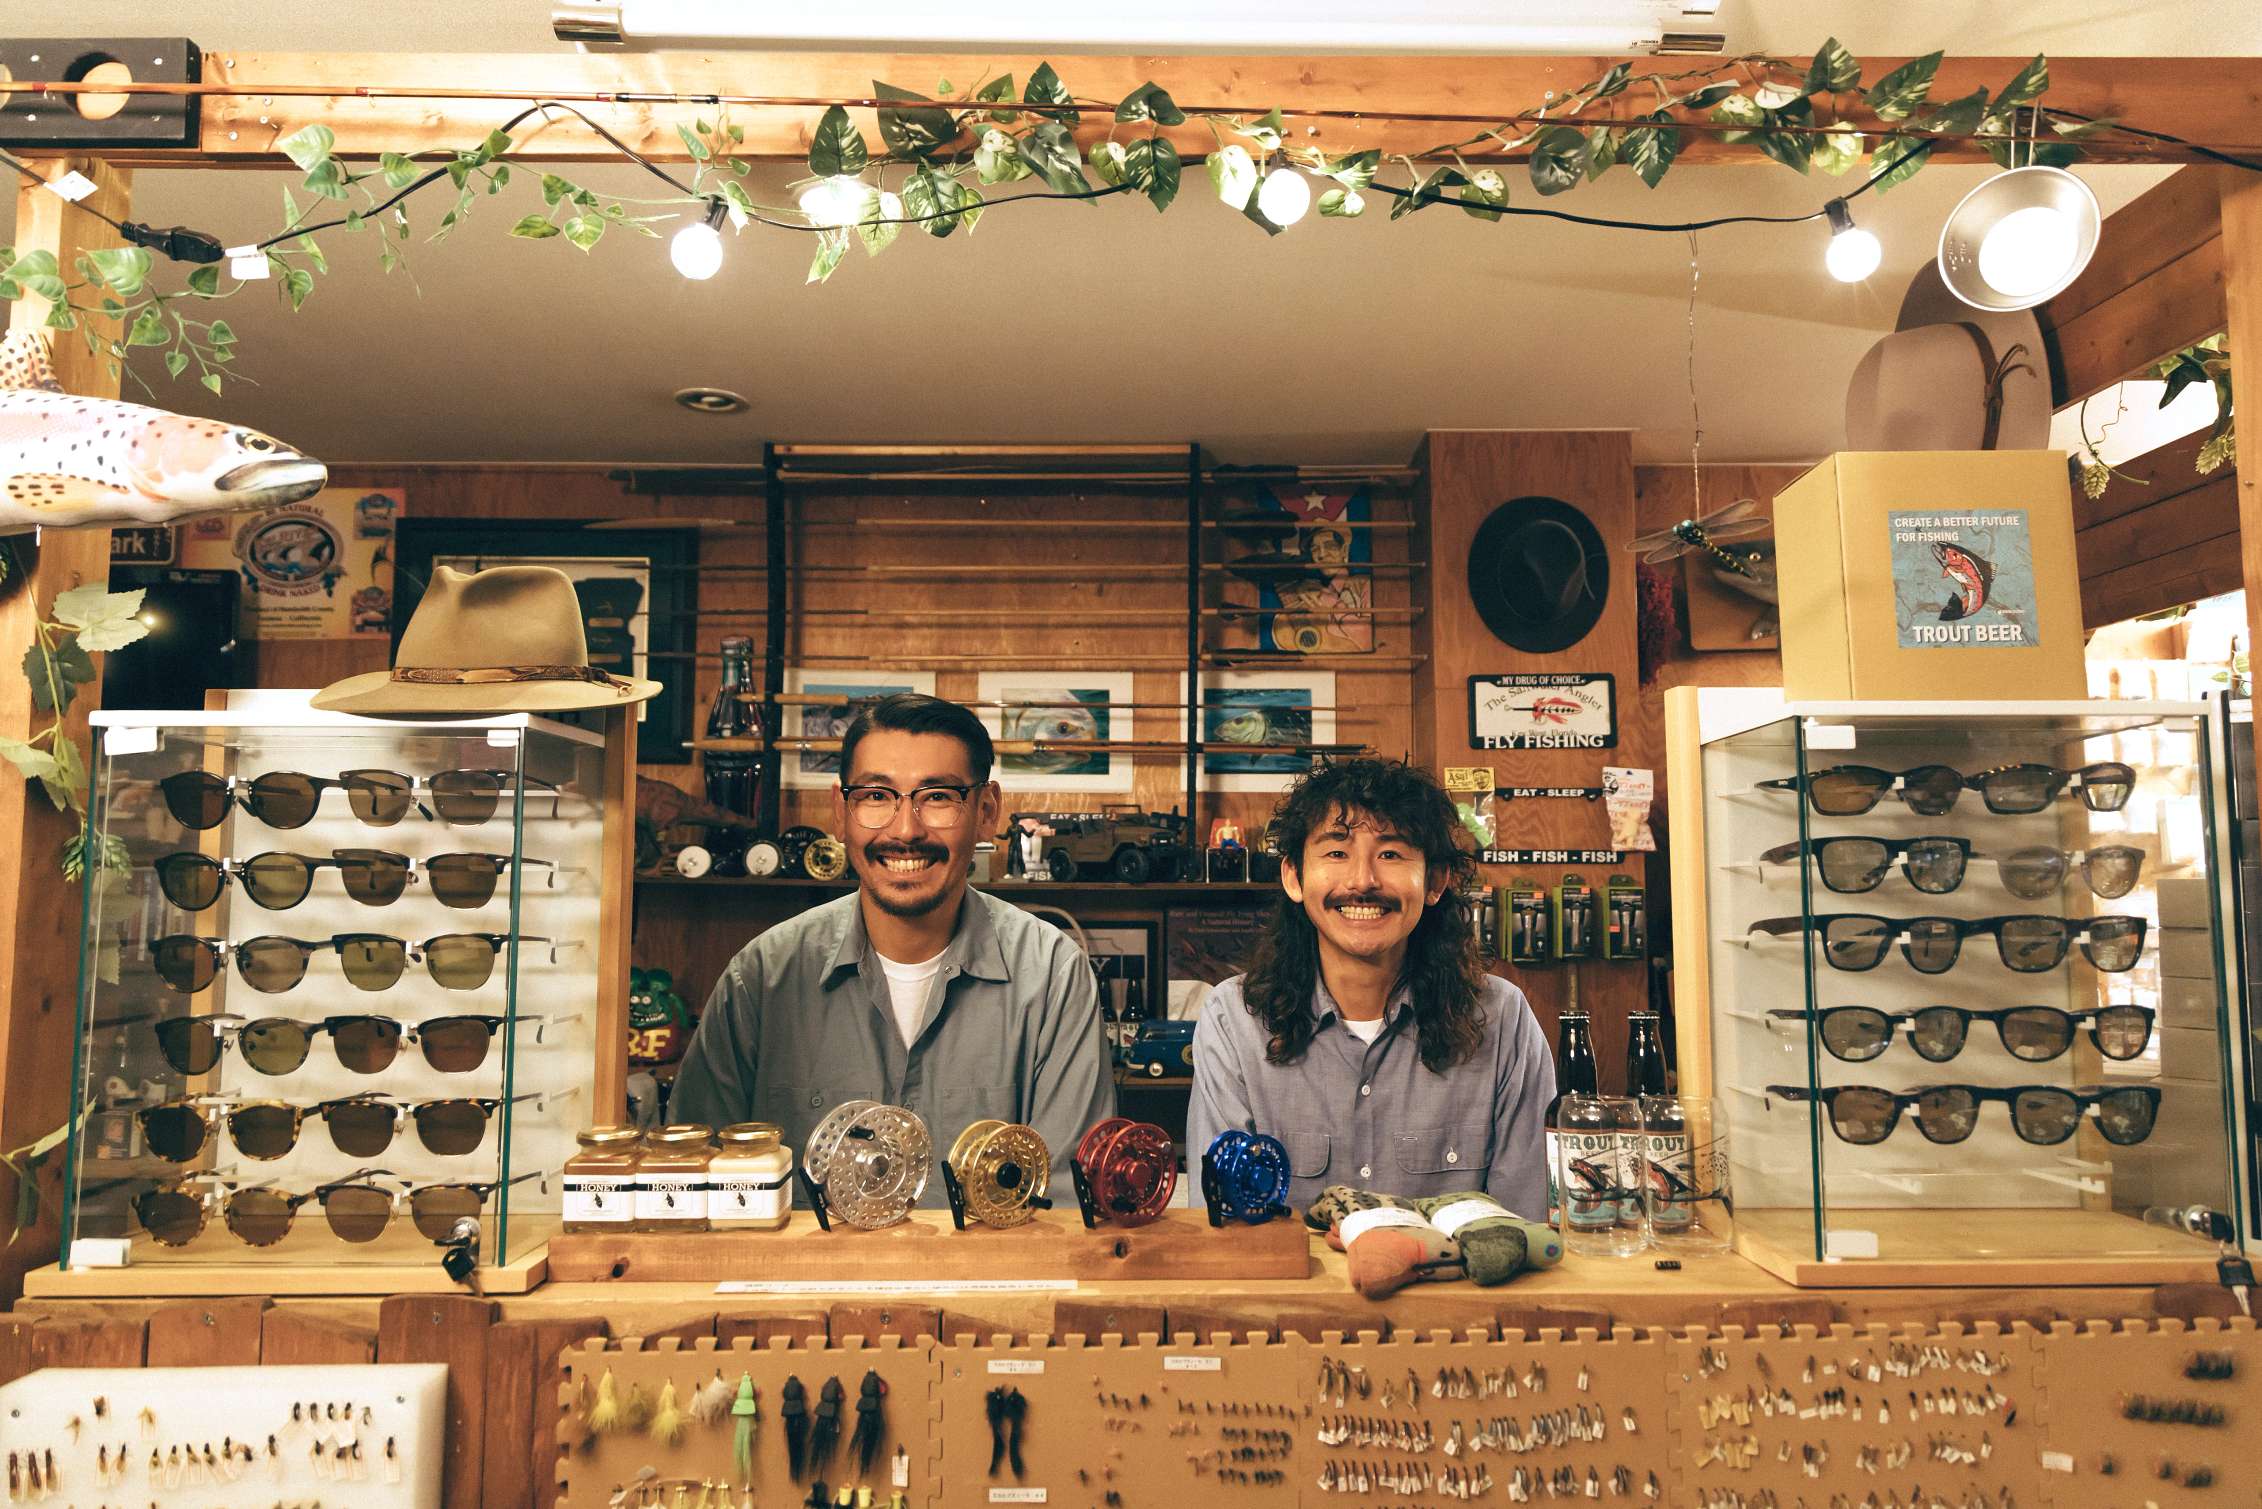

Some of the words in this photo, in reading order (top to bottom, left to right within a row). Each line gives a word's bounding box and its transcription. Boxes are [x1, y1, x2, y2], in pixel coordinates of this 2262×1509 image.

[1895, 517, 1932, 528] CREATE
[1933, 517, 1941, 527] A
[1943, 516, 1979, 527] BETTER
[1981, 516, 2020, 526] FUTURE
[111, 530, 145, 554] ark
[1896, 532, 1916, 542] FOR
[1918, 531, 1960, 542] FISHING
[1912, 625, 1972, 643] TROUT
[1975, 624, 2023, 642] BEER
[1502, 676, 1514, 685] MY
[1515, 676, 1538, 685] DRUG
[1539, 676, 1549, 684] OF
[1551, 675, 1581, 684] CHOICE
[1484, 695, 1507, 711] The
[1564, 686, 1605, 711] Angler
[1484, 736, 1518, 749] FLY
[1525, 735, 1605, 748] FISHING
[1513, 789, 1537, 797] EAT
[1547, 788, 1585, 797] SLEEP
[1483, 851, 1519, 862] FISH
[1532, 851, 1568, 862] FISH
[1582, 851, 1618, 862] FISH
[580, 1183, 617, 1192] HONEY
[652, 1183, 689, 1191] HONEY
[723, 1182, 760, 1191] HONEY
